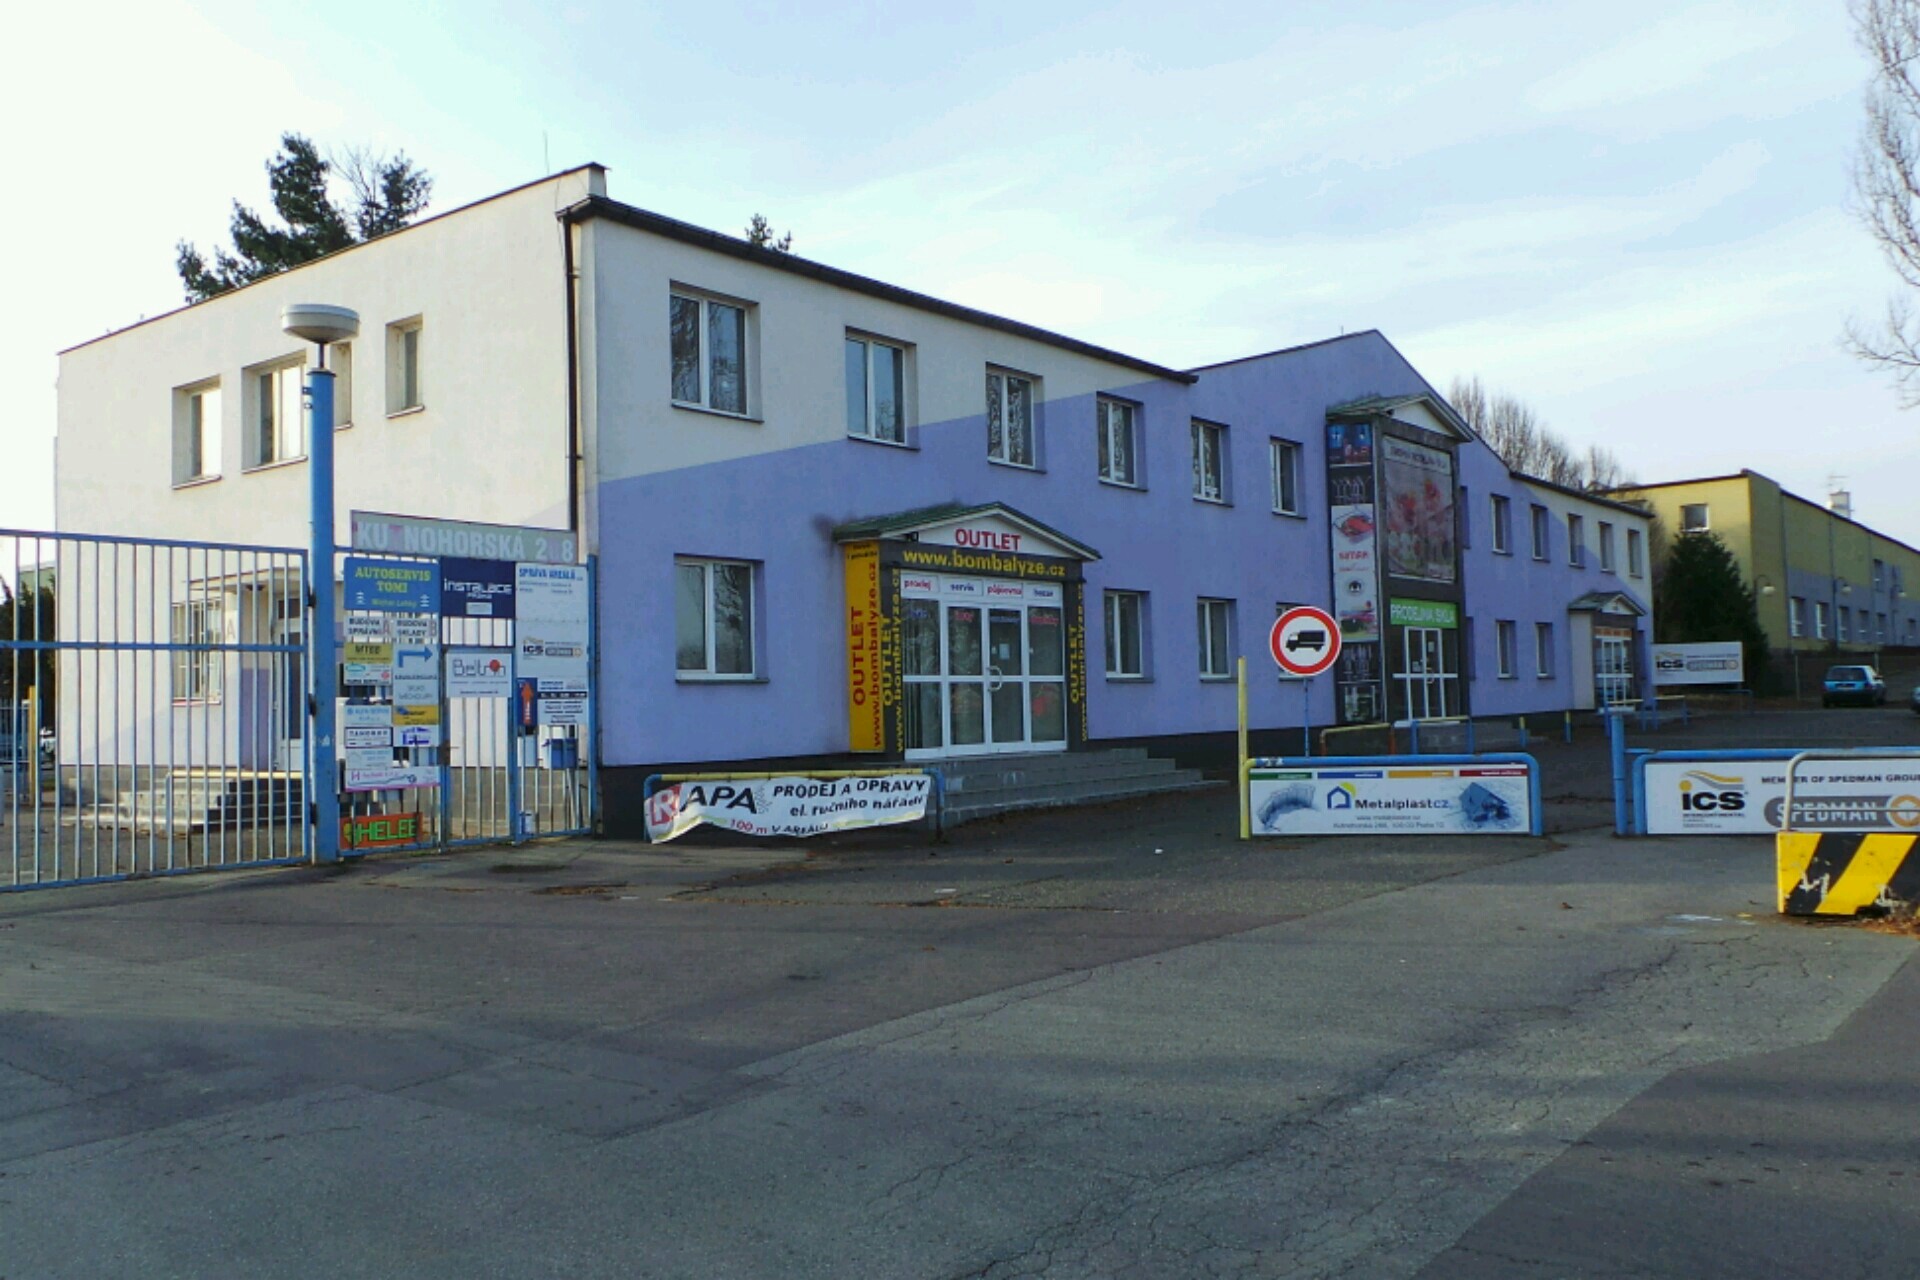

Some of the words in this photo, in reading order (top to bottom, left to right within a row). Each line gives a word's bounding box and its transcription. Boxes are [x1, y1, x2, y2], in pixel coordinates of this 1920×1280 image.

[356, 520, 525, 560] KUNOHORSKÁ
[535, 538, 574, 562] 28
[955, 528, 1021, 550] OUTLET
[903, 550, 1065, 576] www.bombalyze.cz
[355, 567, 431, 581] AUTOSERVIS
[376, 580, 408, 593] TOMI
[951, 582, 974, 592] servis
[851, 606, 865, 706] OUTLET
[867, 562, 881, 747] www.bombalyze.cz
[881, 616, 893, 706] OUTLET
[1068, 623, 1079, 704] OUTLET
[773, 783, 837, 798] PRODEJ
[841, 783, 850, 795] A
[857, 780, 926, 793] OPRAVY
[1762, 775, 1808, 784] MEMER
[1811, 775, 1823, 783] OF
[1828, 775, 1882, 784] SPEDMAN
[811, 797, 868, 816] ručního
[731, 819, 753, 833] 100
